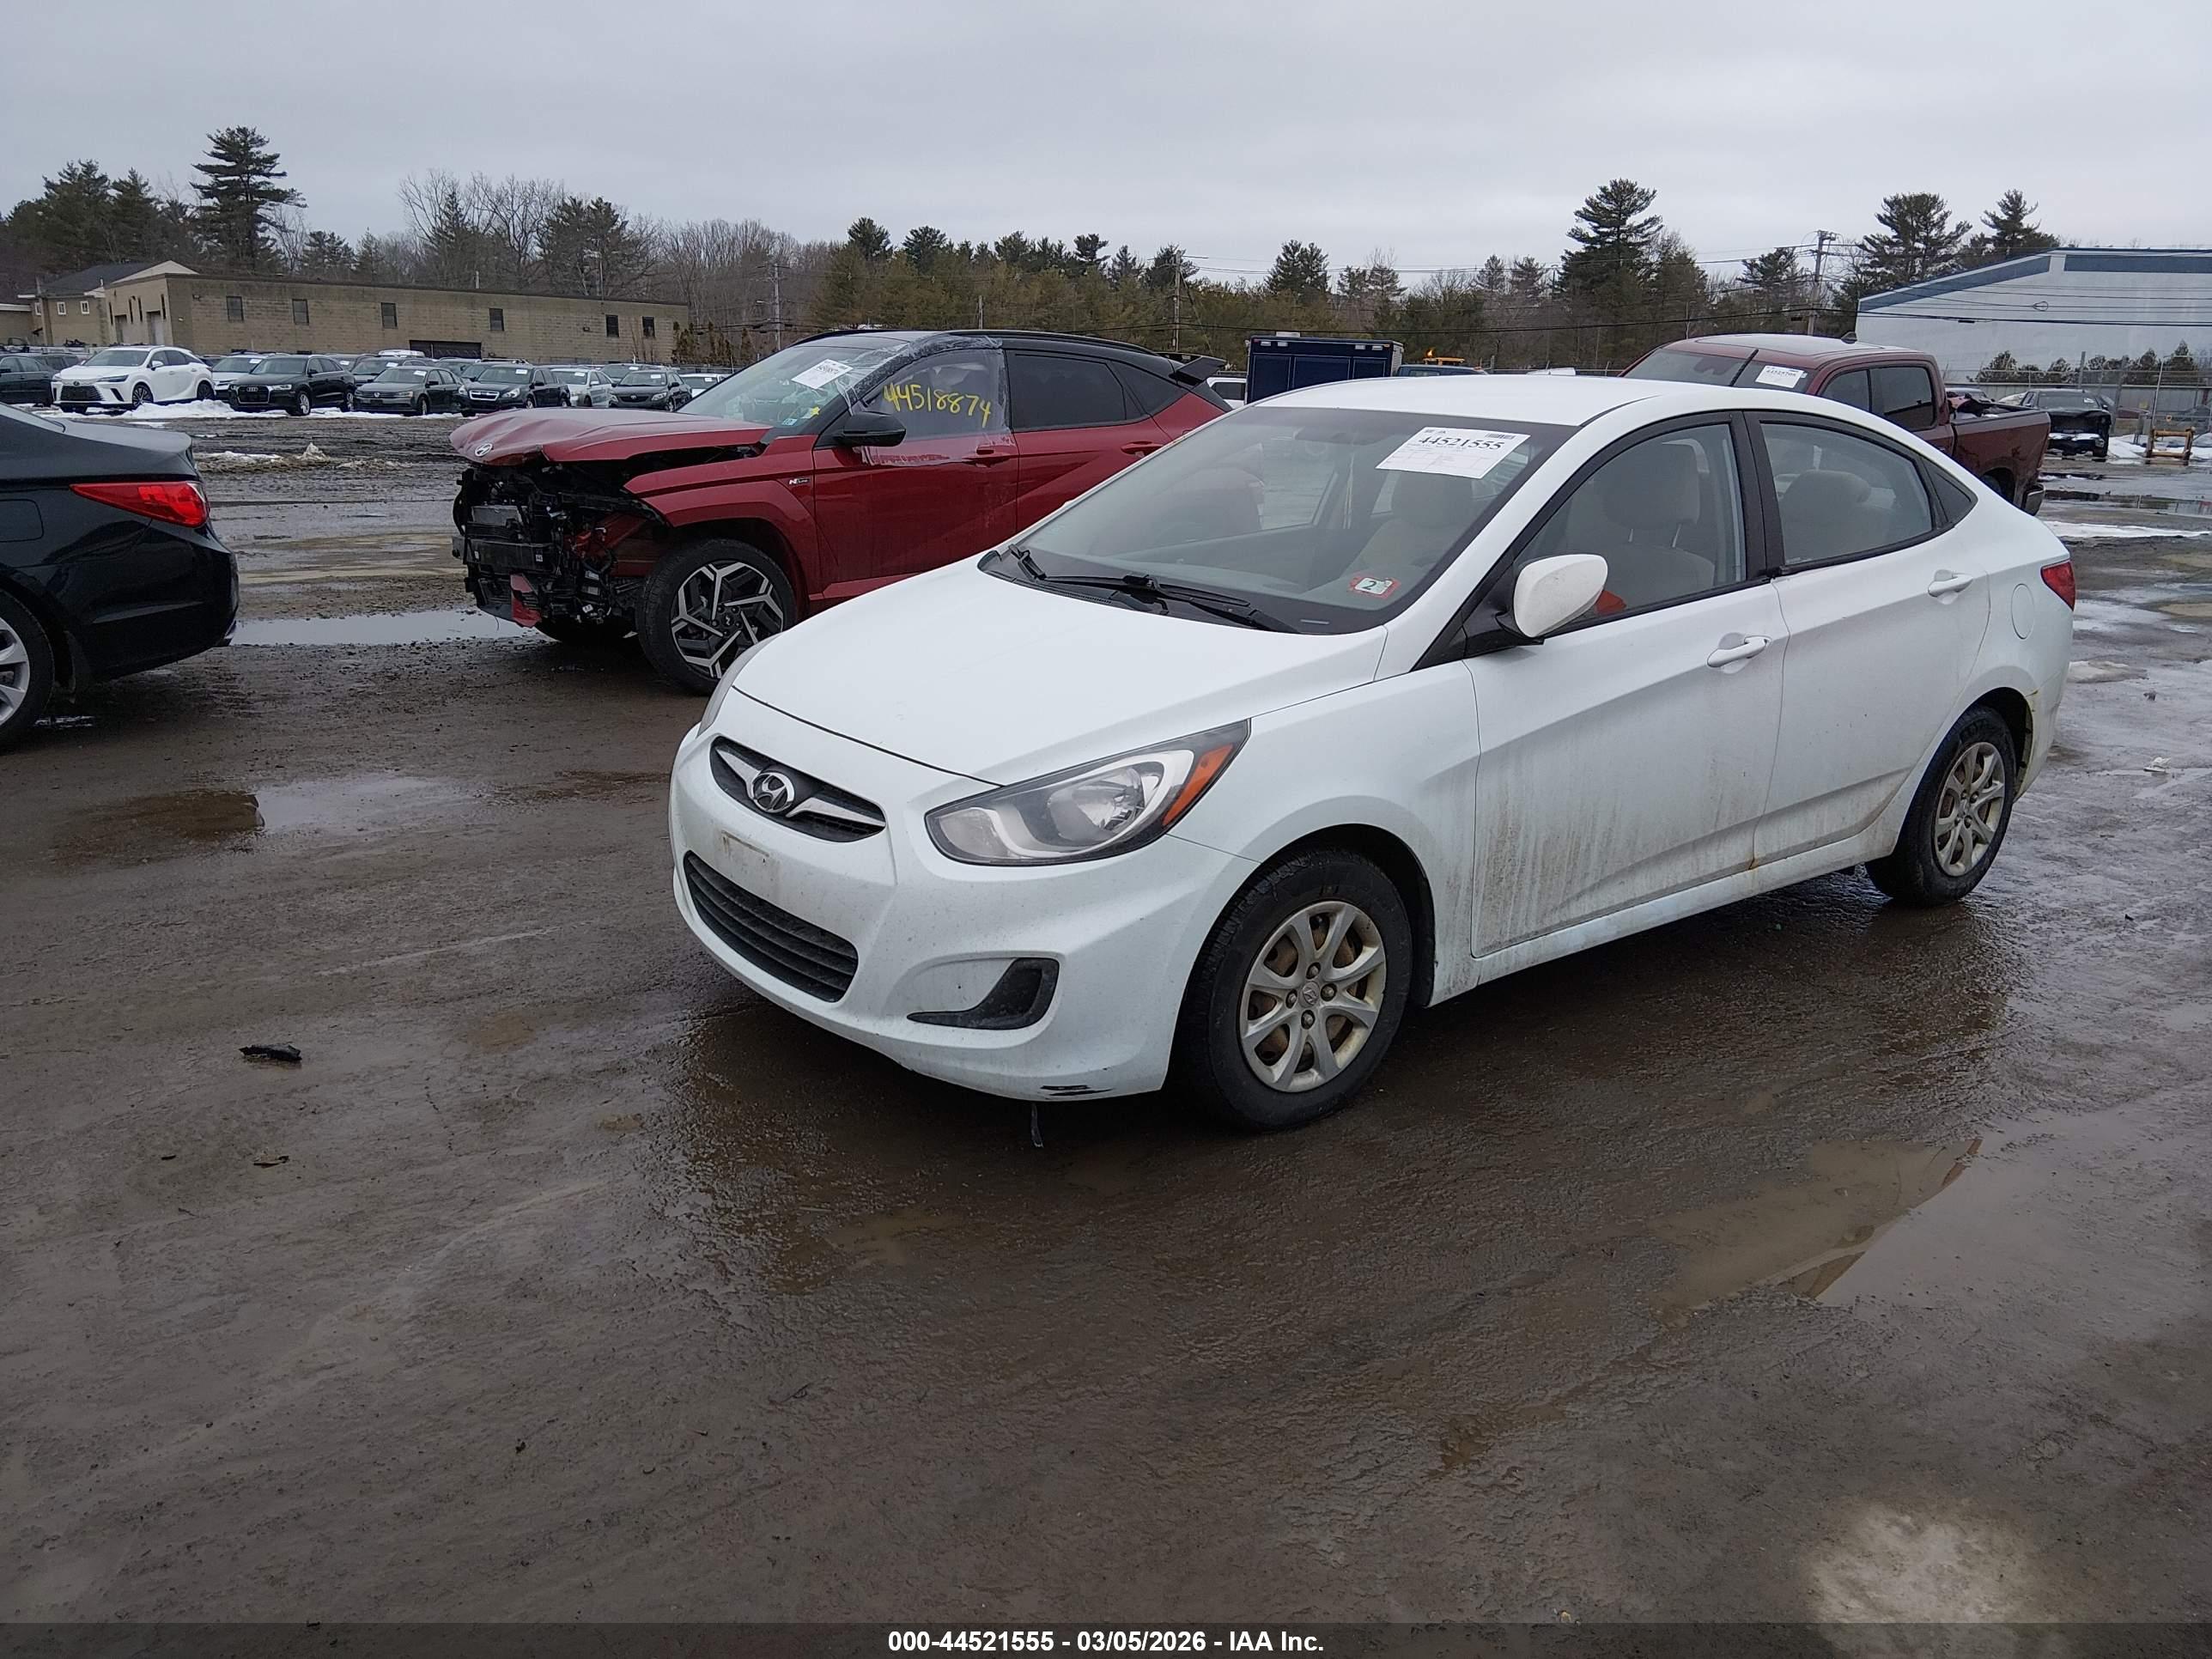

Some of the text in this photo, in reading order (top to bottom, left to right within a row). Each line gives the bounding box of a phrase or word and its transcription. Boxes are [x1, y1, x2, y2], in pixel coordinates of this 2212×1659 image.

[883, 383, 991, 428] 44518874
[1419, 436, 1504, 449] 44521555
[1363, 580, 1376, 590] 2
